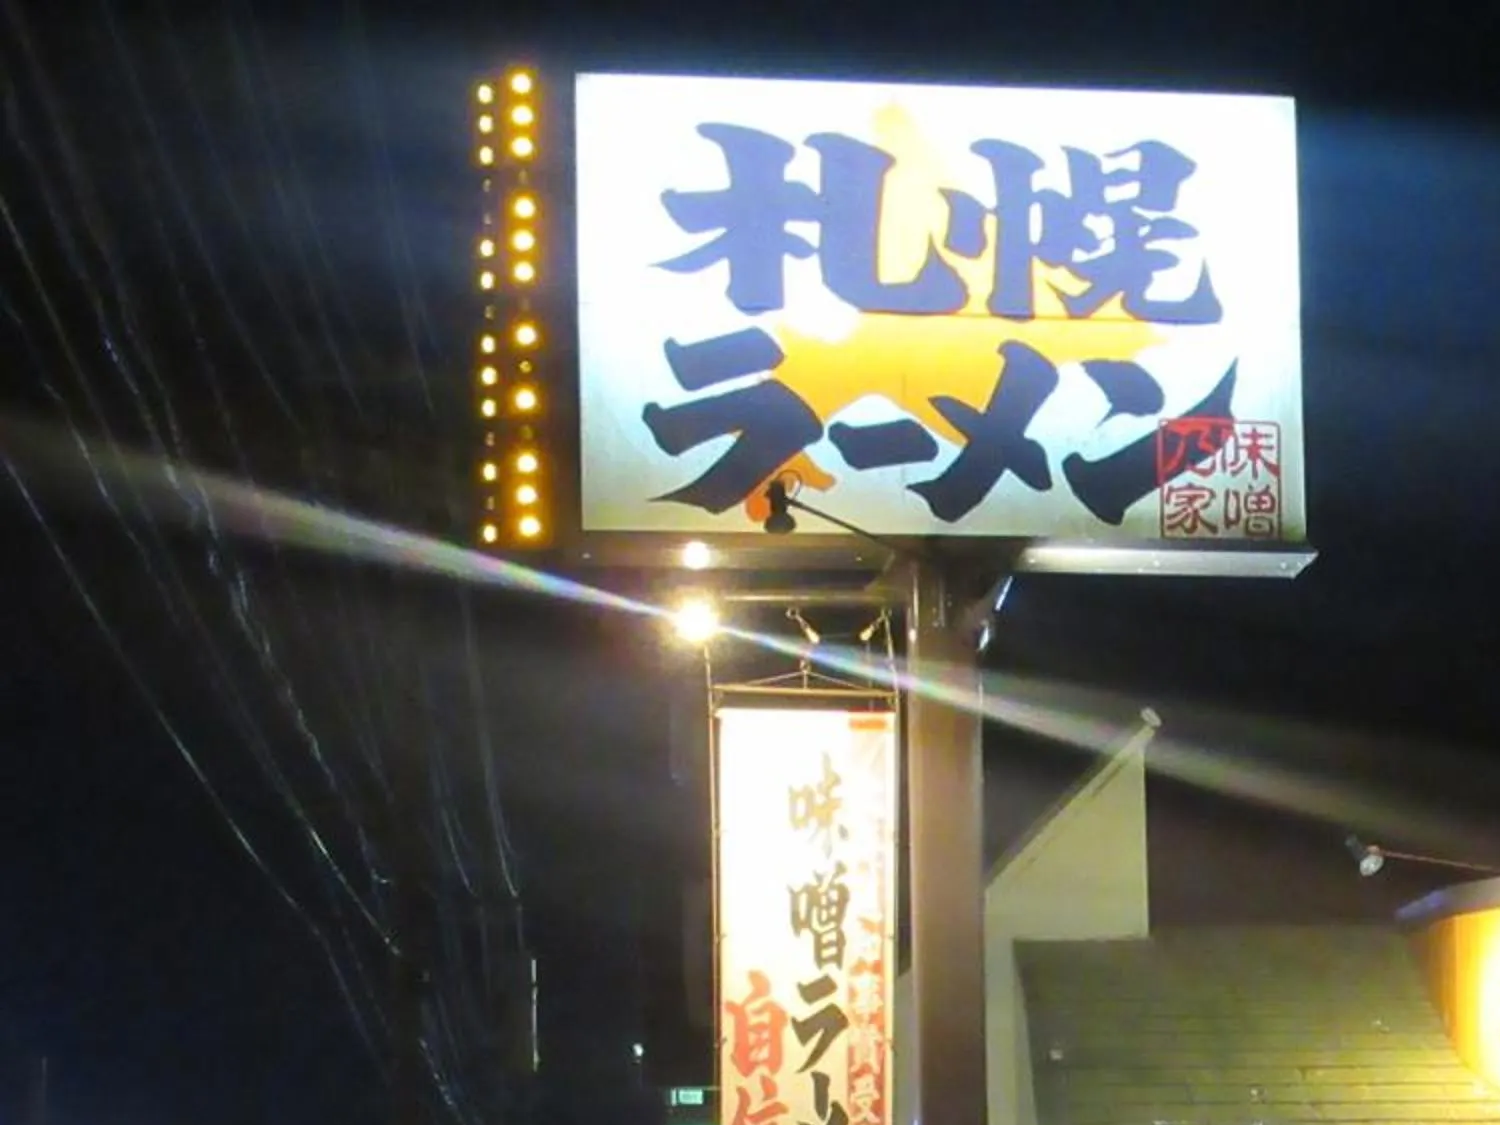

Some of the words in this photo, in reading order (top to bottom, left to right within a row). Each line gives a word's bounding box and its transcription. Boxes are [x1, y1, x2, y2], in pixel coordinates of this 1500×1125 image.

[649, 122, 1223, 324] 札幌
[642, 326, 1240, 525] ラーメン
